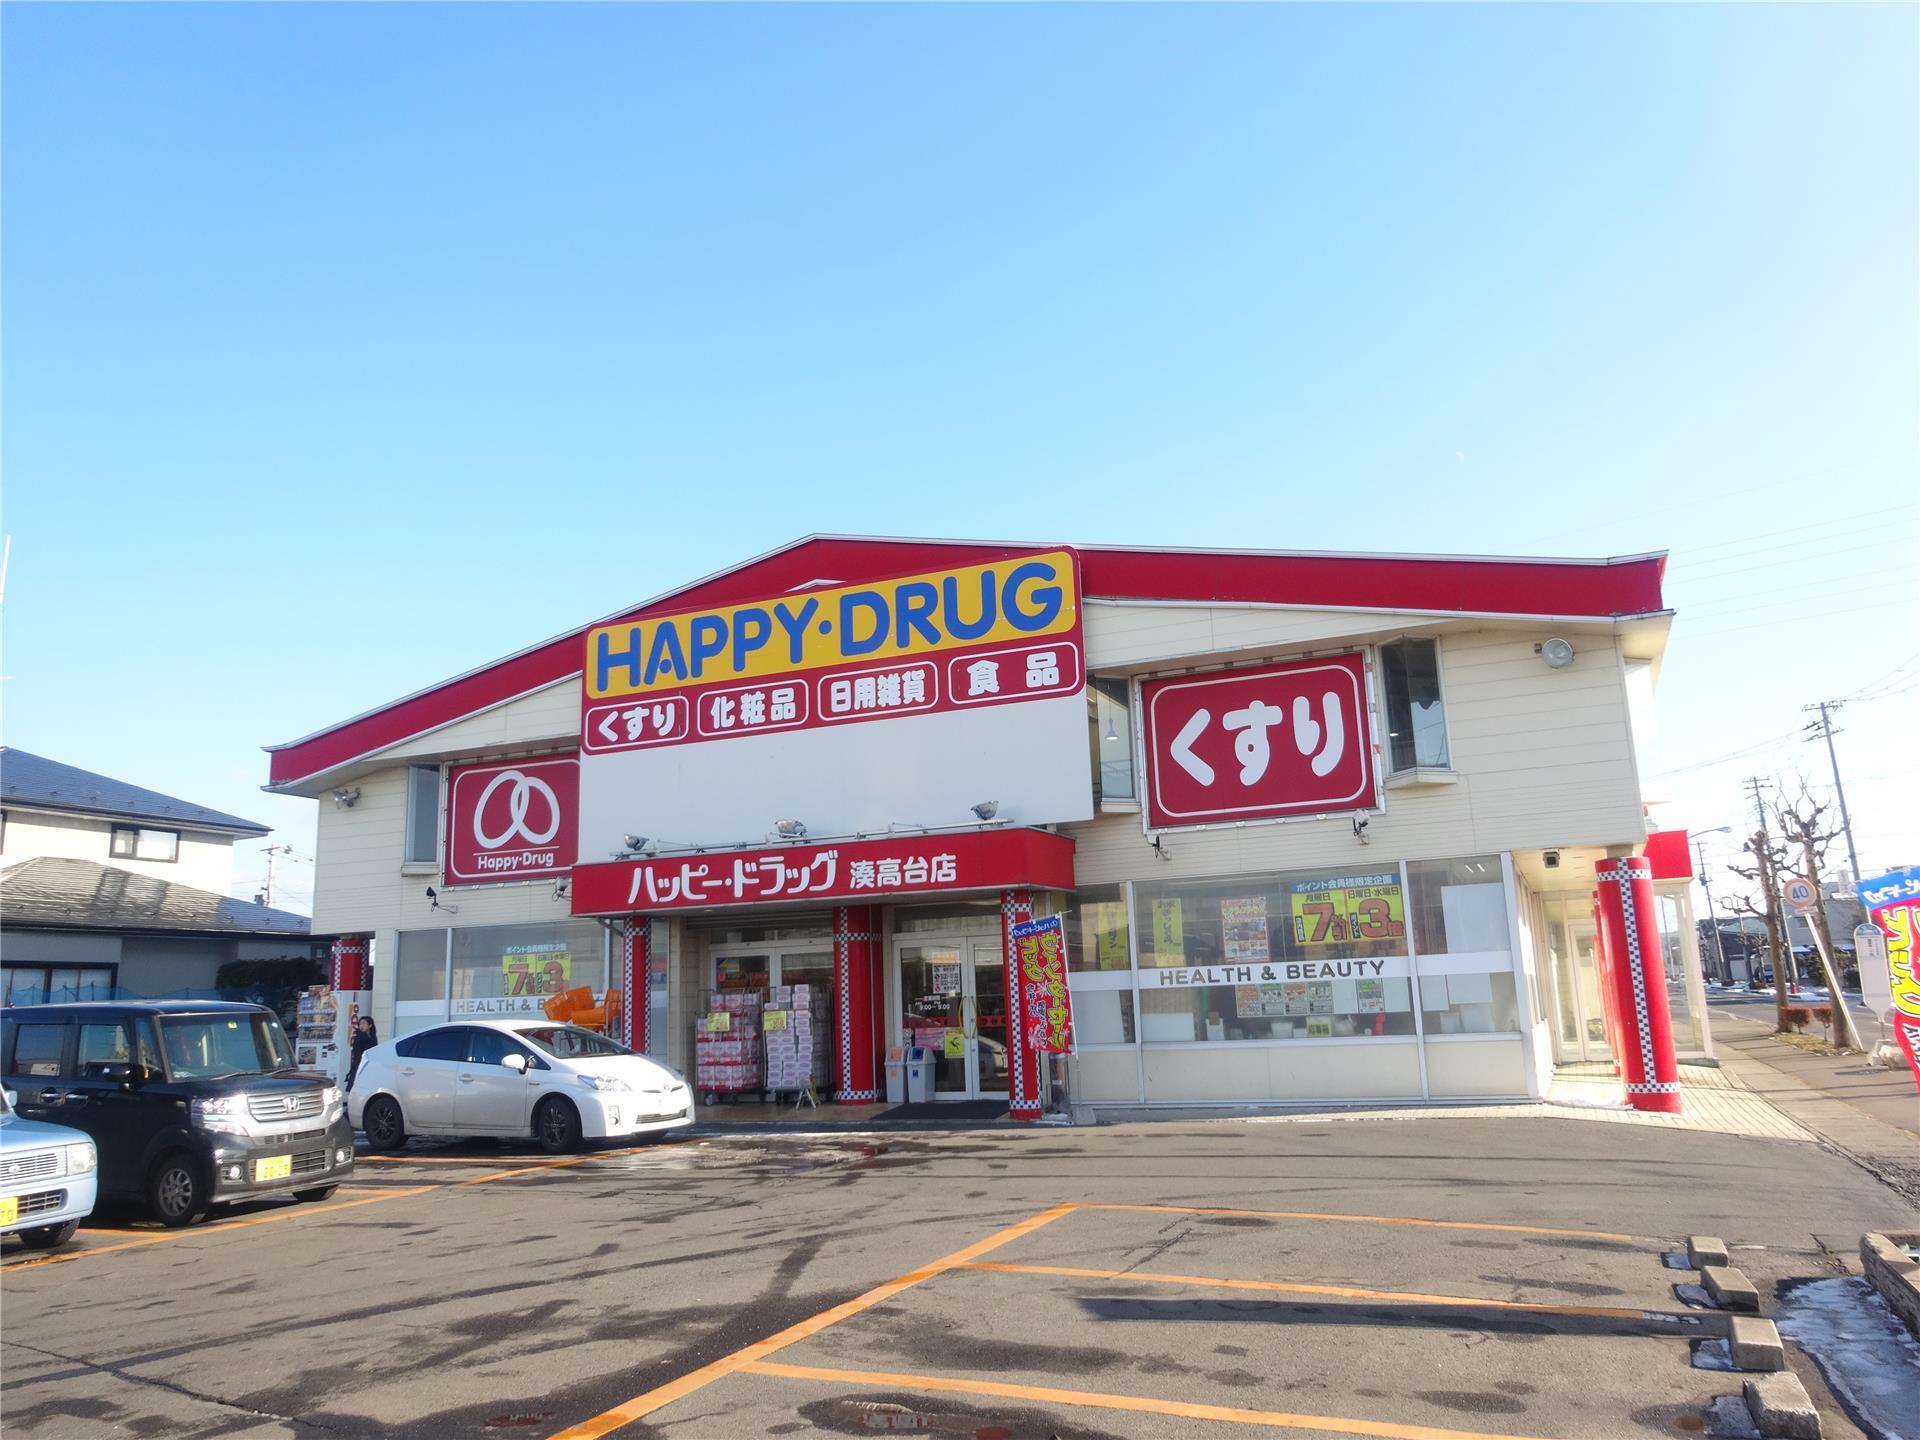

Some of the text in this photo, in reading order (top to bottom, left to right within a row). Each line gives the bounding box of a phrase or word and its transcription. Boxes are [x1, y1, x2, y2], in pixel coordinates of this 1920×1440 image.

[830, 669, 925, 713] 日用雑貨
[966, 651, 1060, 696] 食品
[598, 702, 676, 742] くすり
[710, 687, 796, 729] 化粧品
[1170, 691, 1345, 787] くすり
[849, 853, 956, 889] 湊高台店
[1792, 885, 1809, 899] 40
[1160, 960, 1385, 986] HEALTH & BEAUTY
[456, 1000, 515, 1013] HEALTH
